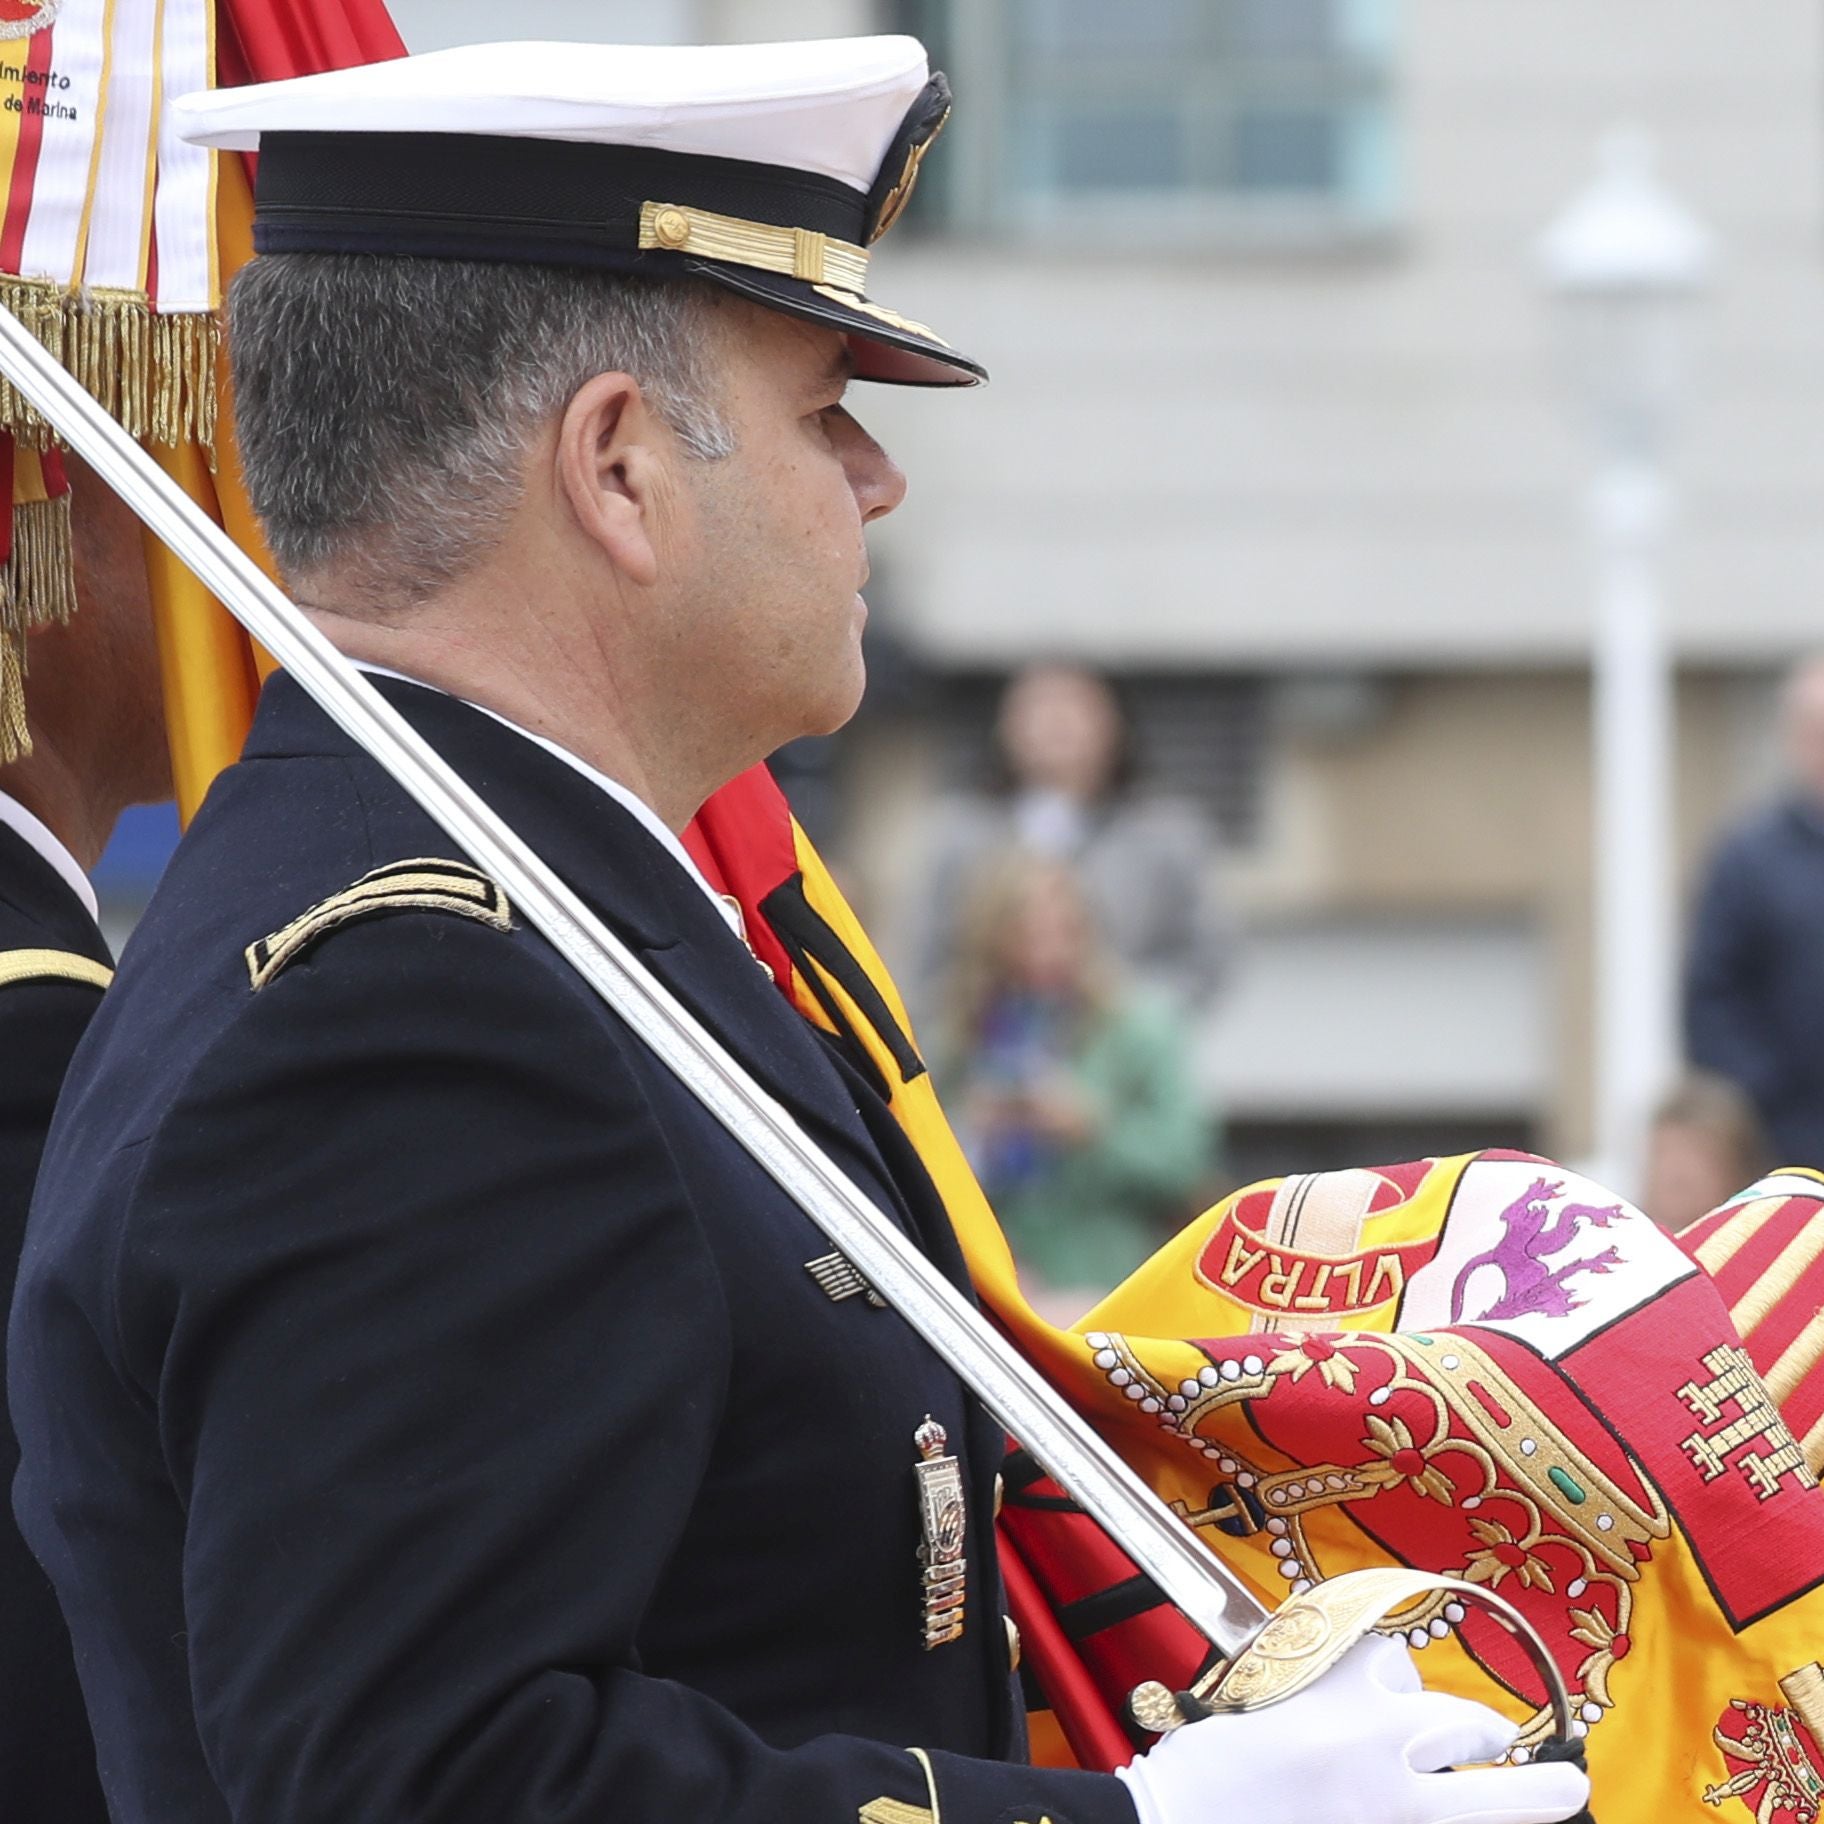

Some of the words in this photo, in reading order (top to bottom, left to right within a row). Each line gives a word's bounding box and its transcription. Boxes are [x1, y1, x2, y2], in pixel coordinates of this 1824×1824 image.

[4, 93, 23, 112] de
[27, 97, 77, 120] Marina
[1219, 1233, 1405, 1309] VLTRA
